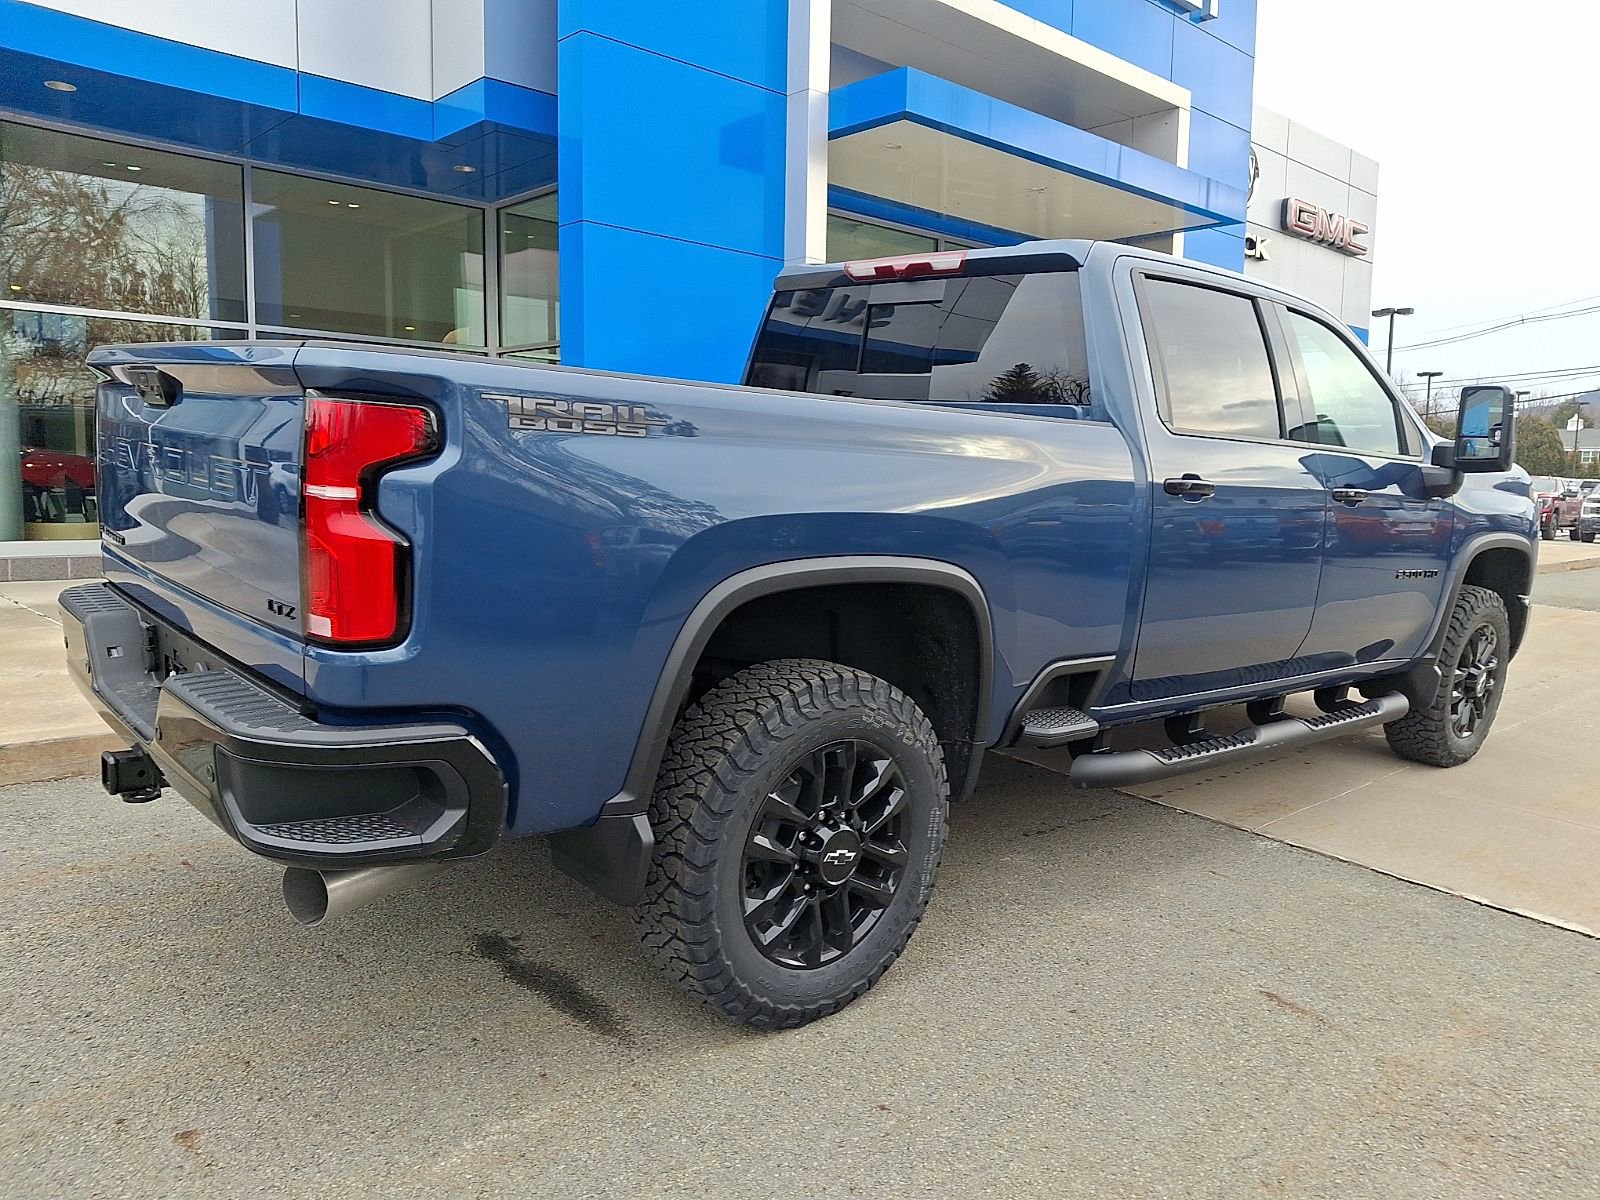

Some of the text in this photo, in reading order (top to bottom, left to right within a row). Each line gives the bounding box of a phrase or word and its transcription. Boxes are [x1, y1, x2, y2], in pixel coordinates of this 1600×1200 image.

[1284, 197, 1369, 256] GMC
[480, 393, 668, 427] TRAIL
[508, 414, 648, 438] BOSS
[266, 598, 297, 620] LTZ
